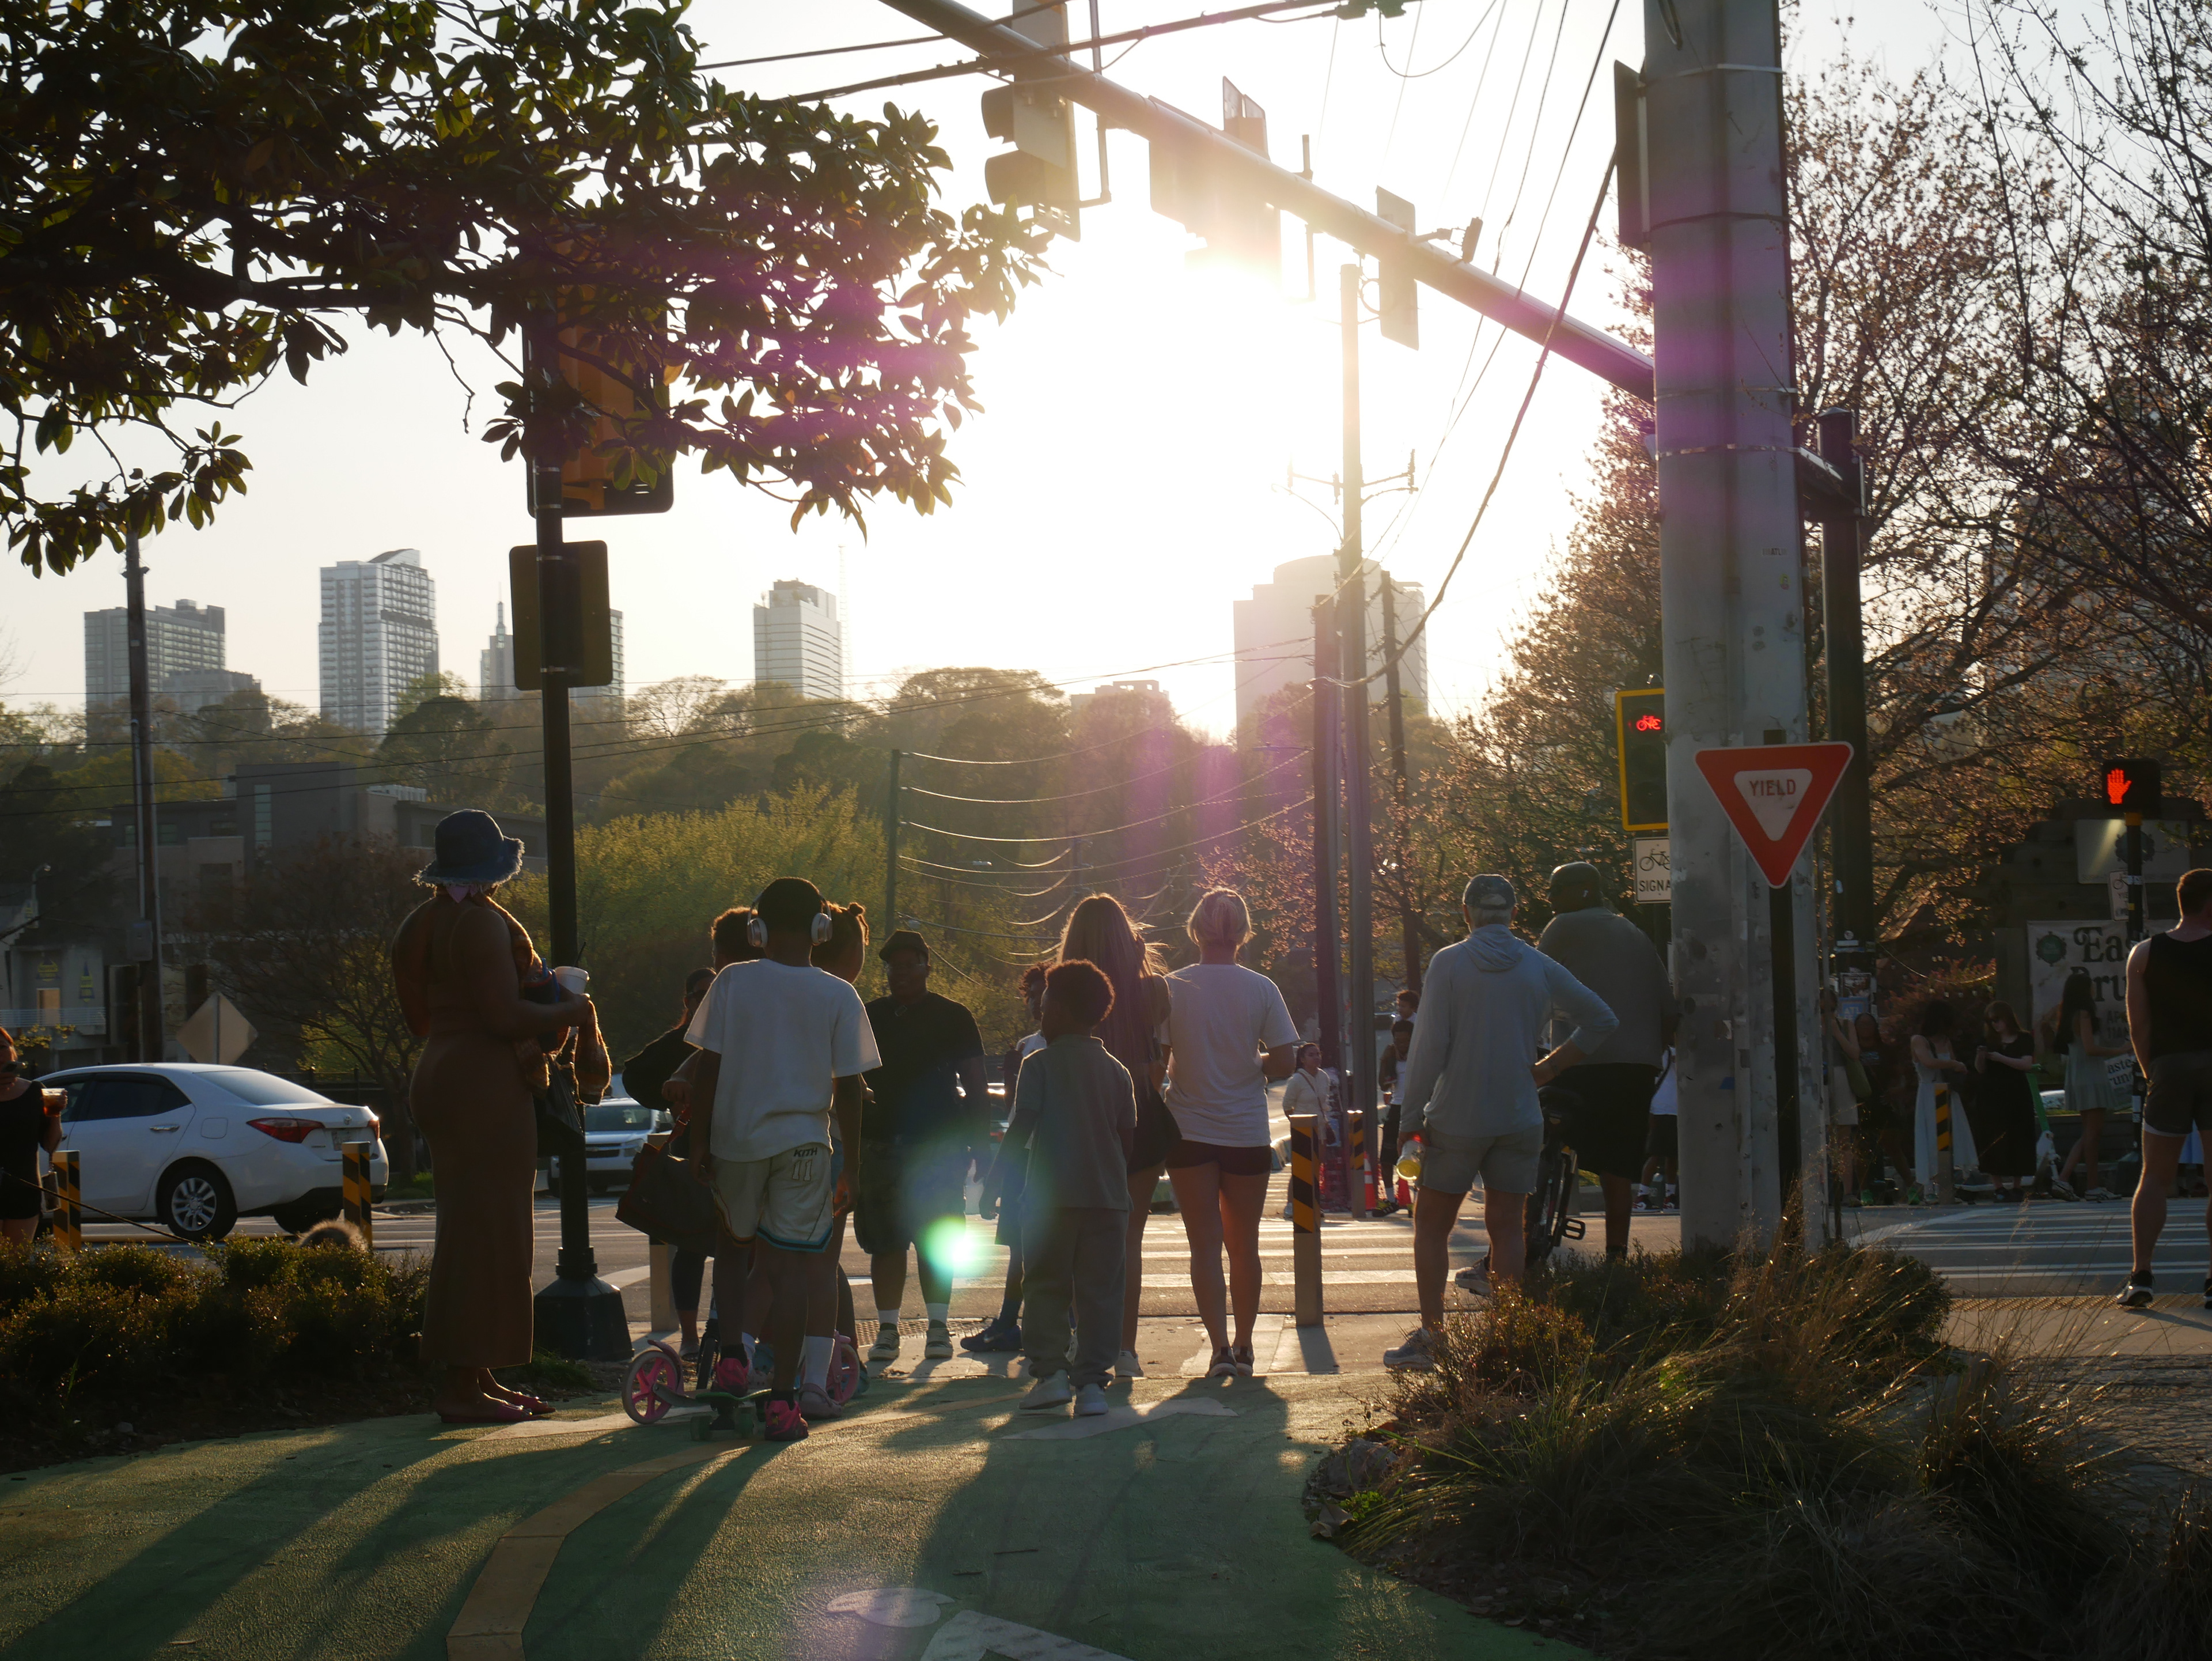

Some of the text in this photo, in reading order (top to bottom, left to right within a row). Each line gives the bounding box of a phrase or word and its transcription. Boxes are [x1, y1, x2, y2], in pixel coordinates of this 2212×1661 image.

[1749, 780, 1796, 797] YIELD
[793, 1147, 818, 1157] KITH
[791, 1159, 813, 1182] 11
